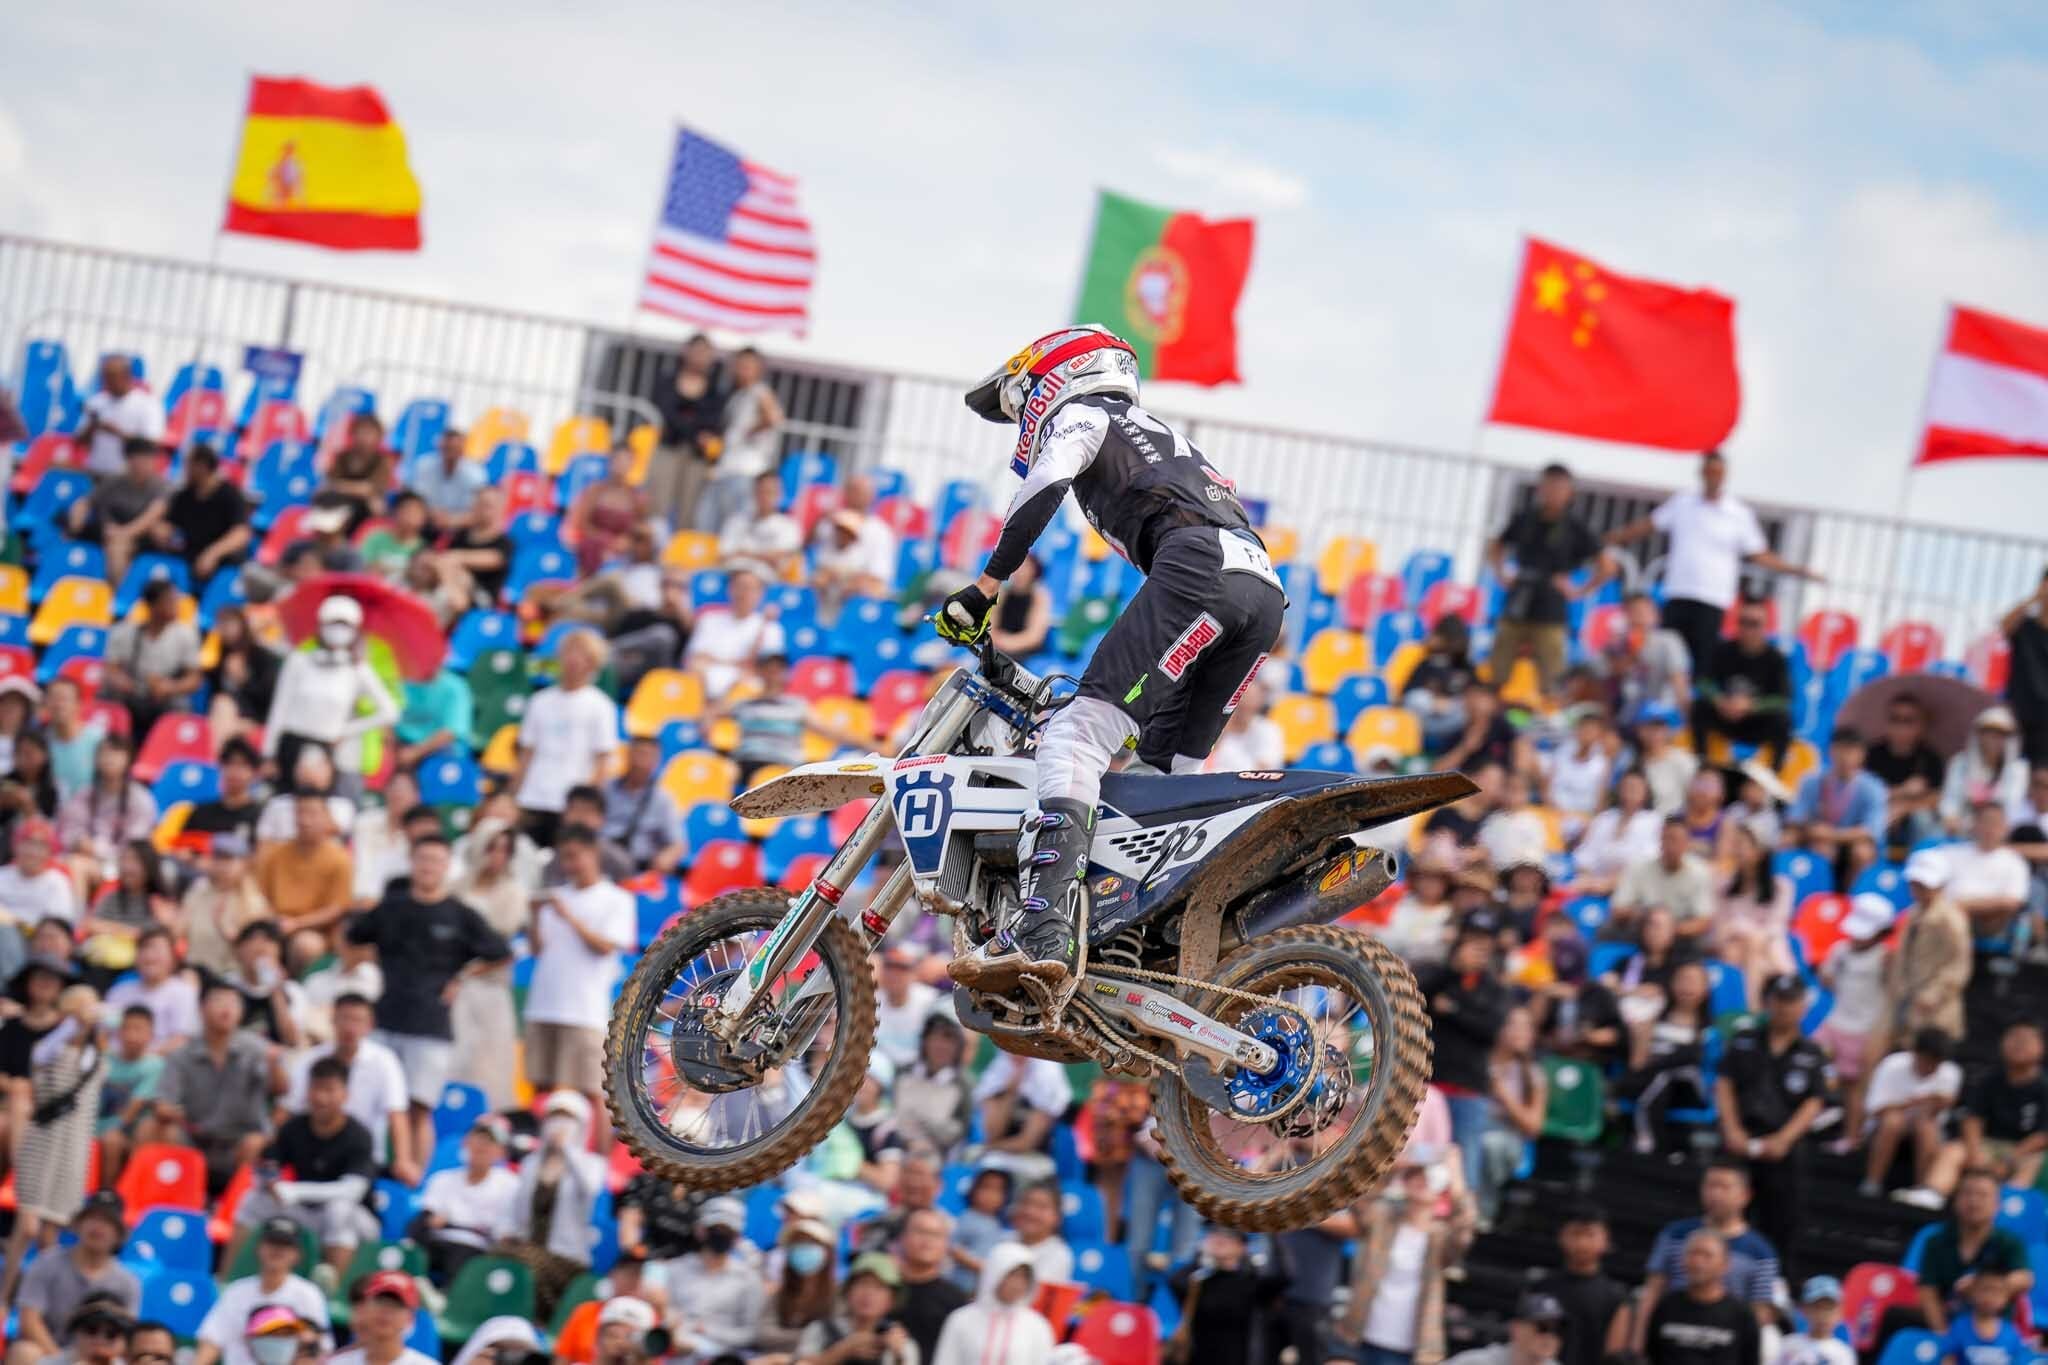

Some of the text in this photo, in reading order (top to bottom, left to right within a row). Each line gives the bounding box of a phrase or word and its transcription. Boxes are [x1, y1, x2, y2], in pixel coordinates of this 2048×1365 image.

[1070, 351, 1094, 370] BELL
[1015, 371, 1066, 462] Red Bull
